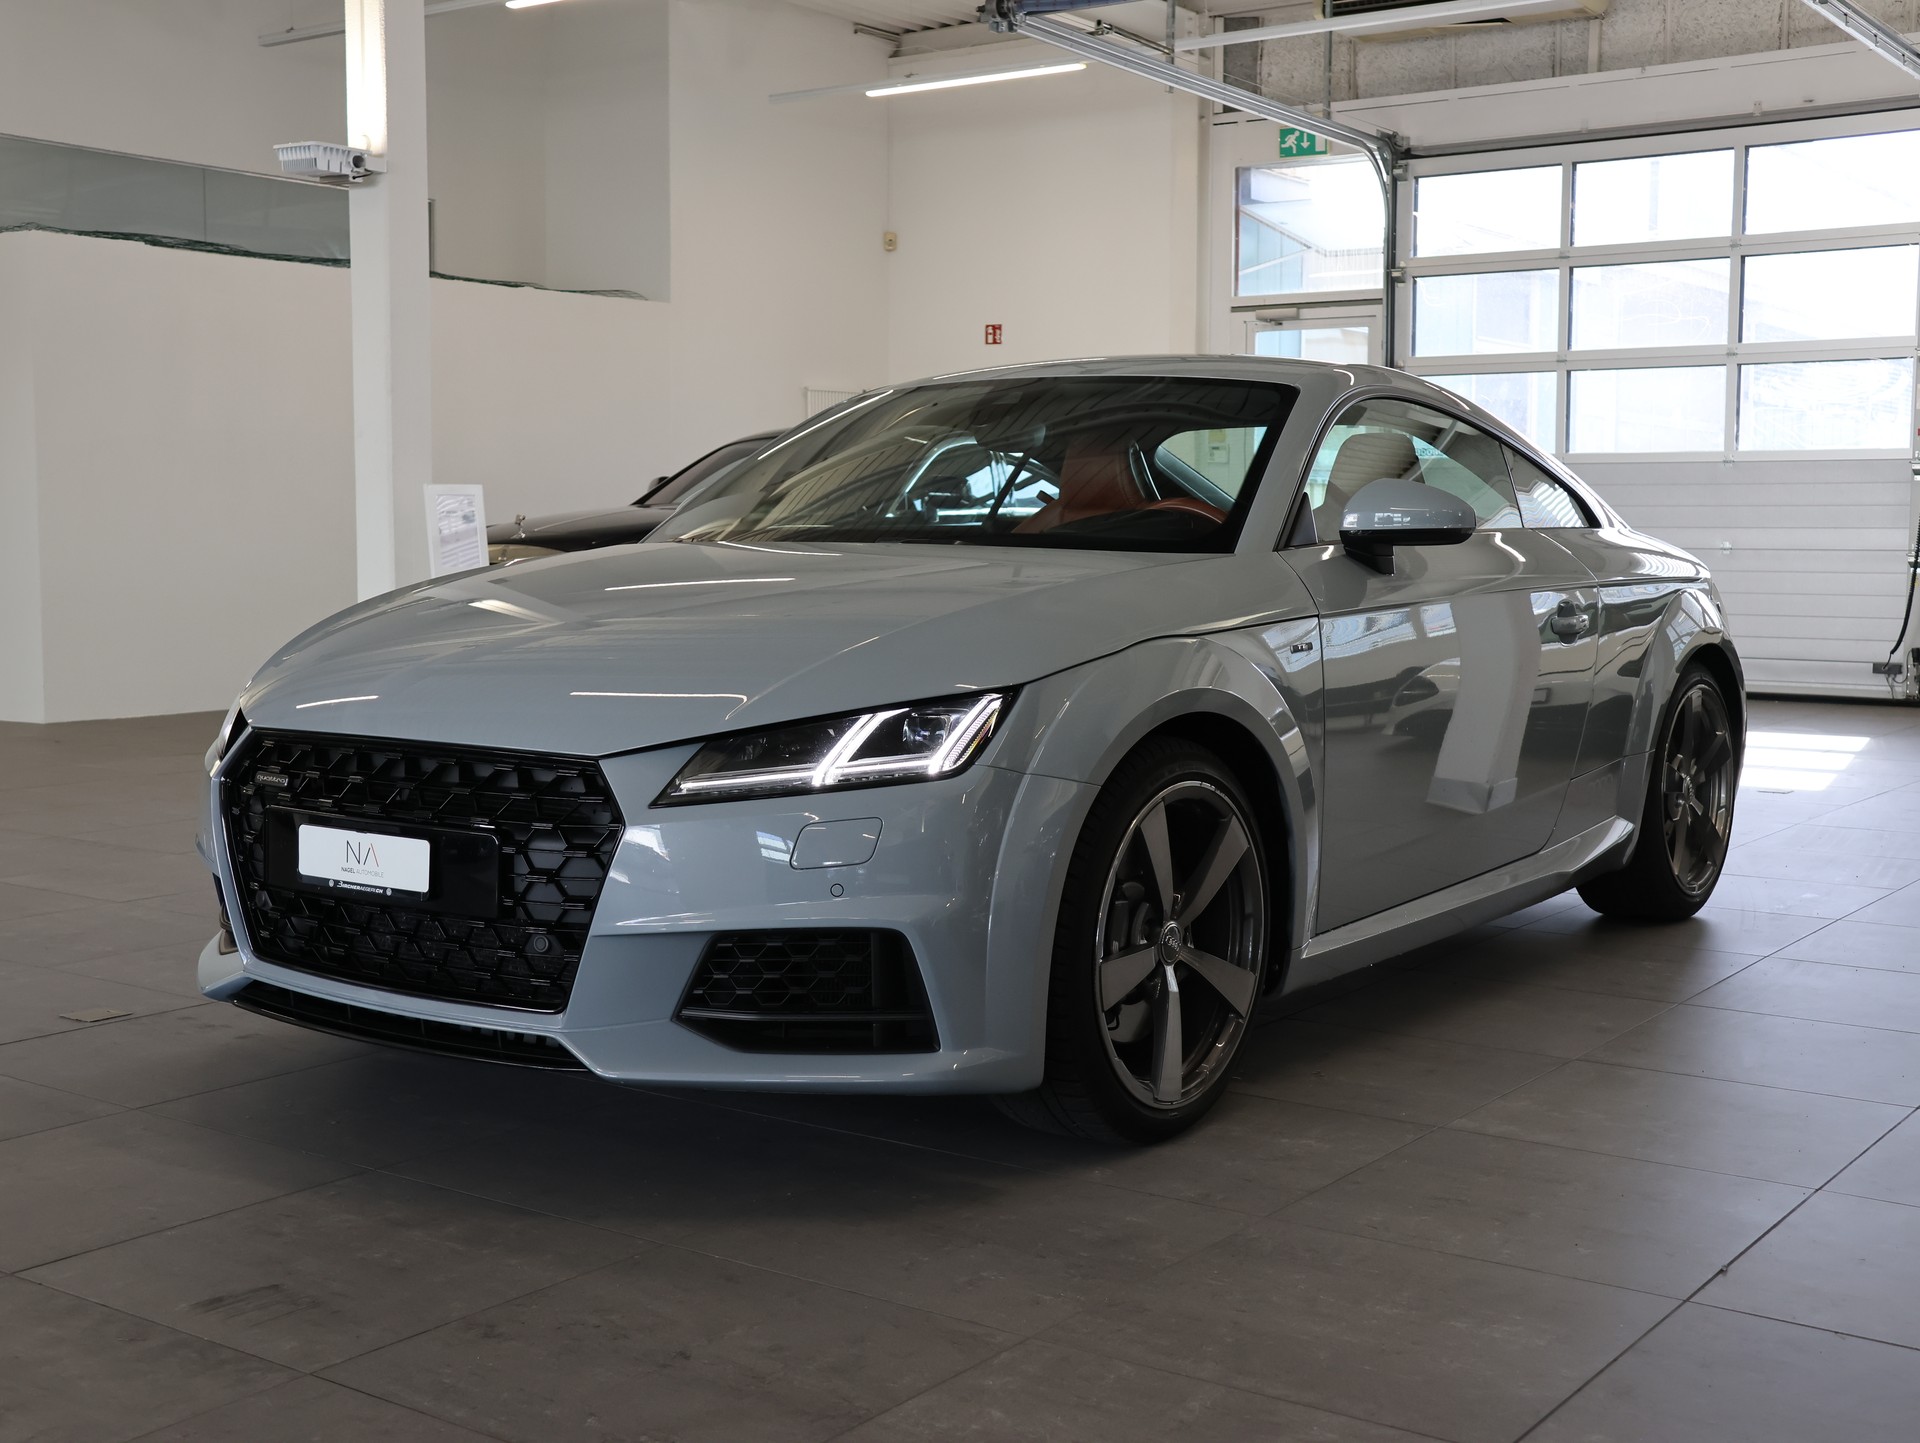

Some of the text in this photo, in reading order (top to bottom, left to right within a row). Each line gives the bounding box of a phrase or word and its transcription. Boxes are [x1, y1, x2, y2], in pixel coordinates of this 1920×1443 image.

[257, 774, 286, 783] quattro
[341, 866, 384, 878] NAGEL AUTOMOBILE
